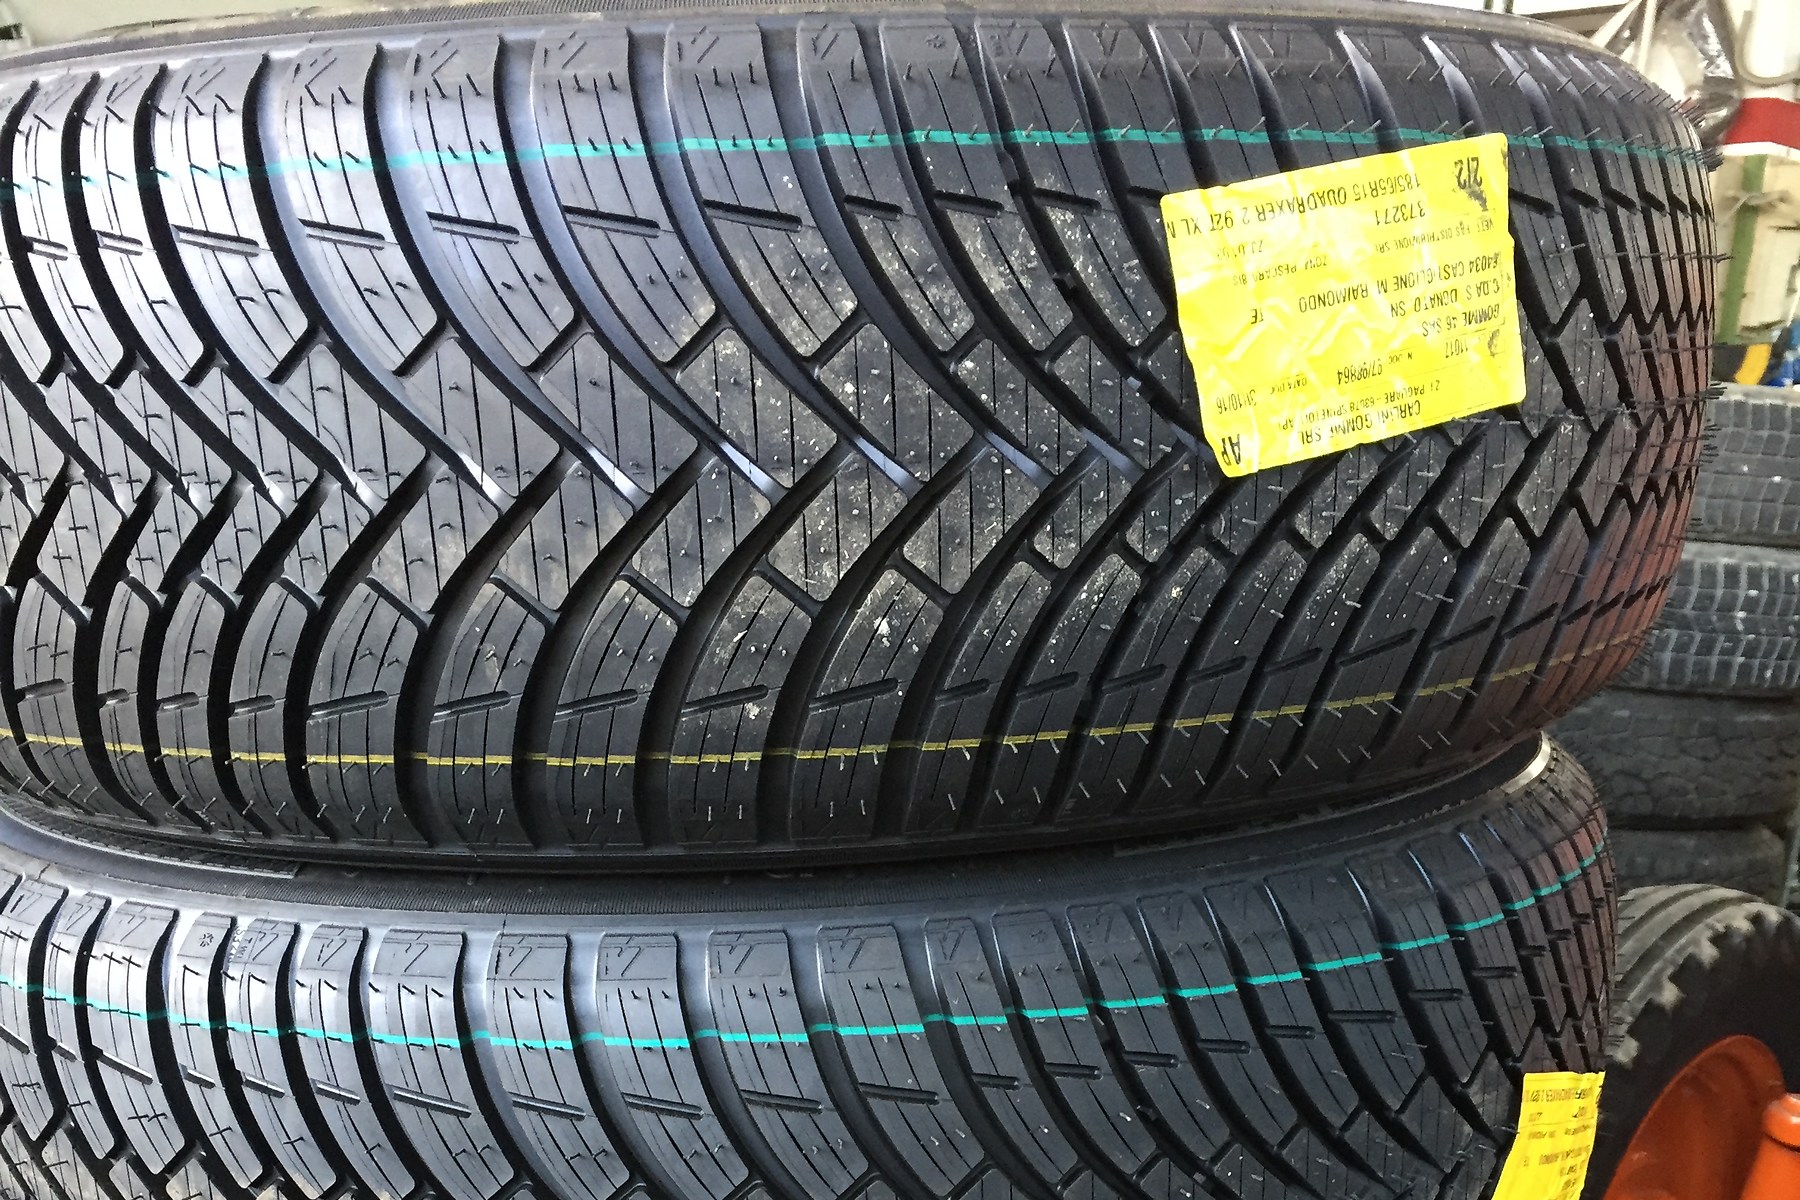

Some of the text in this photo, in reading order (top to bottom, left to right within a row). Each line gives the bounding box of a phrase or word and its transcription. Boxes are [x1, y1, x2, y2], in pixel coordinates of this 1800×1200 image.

[1453, 155, 1483, 191] 2/2
[1352, 172, 1420, 202] 185/65R15
[1254, 186, 1347, 222] QUADRAXER
[1374, 200, 1426, 226] 373271
[1179, 216, 1202, 236] XL
[1298, 283, 1369, 313] RAIMONDO
[1389, 299, 1407, 318] SN
[1420, 316, 1442, 338] SAS
[1461, 302, 1500, 327] GOMME
[1376, 399, 1421, 424] CARLINI
[1297, 427, 1322, 446] SRL
[1220, 433, 1242, 467] AP
